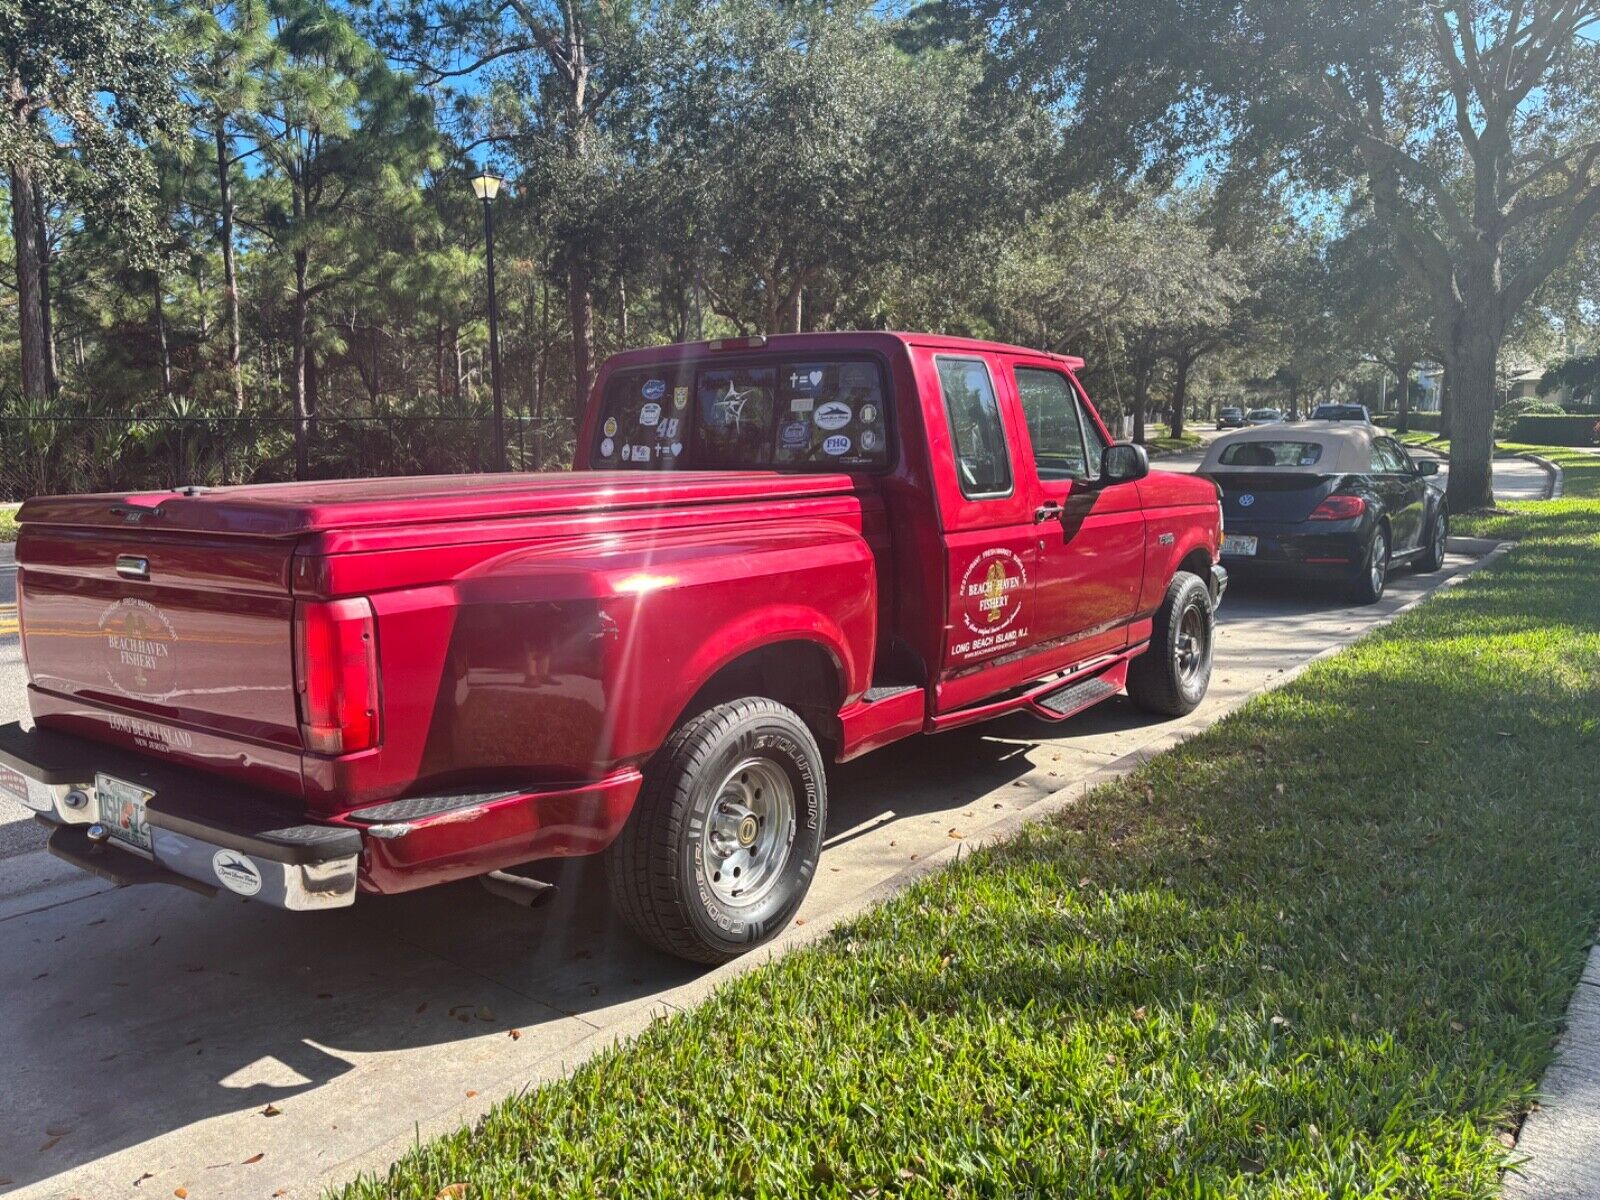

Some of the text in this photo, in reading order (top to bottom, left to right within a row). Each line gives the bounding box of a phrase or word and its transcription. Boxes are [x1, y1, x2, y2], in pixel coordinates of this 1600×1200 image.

[656, 418, 679, 438] 48
[826, 438, 848, 448] FHQ
[969, 576, 1020, 596] BEACH HAVEN
[979, 595, 1009, 612] FISHERY
[108, 635, 168, 657] BEACH HAVEN
[951, 642, 970, 656] LONG
[972, 636, 994, 650] BEACH
[121, 651, 156, 670] FISHERY
[108, 714, 192, 748] LONG BEACH ISLAND
[134, 737, 148, 747] NEW
[754, 734, 817, 830] EVOLUTION
[695, 842, 745, 934] COOPER
